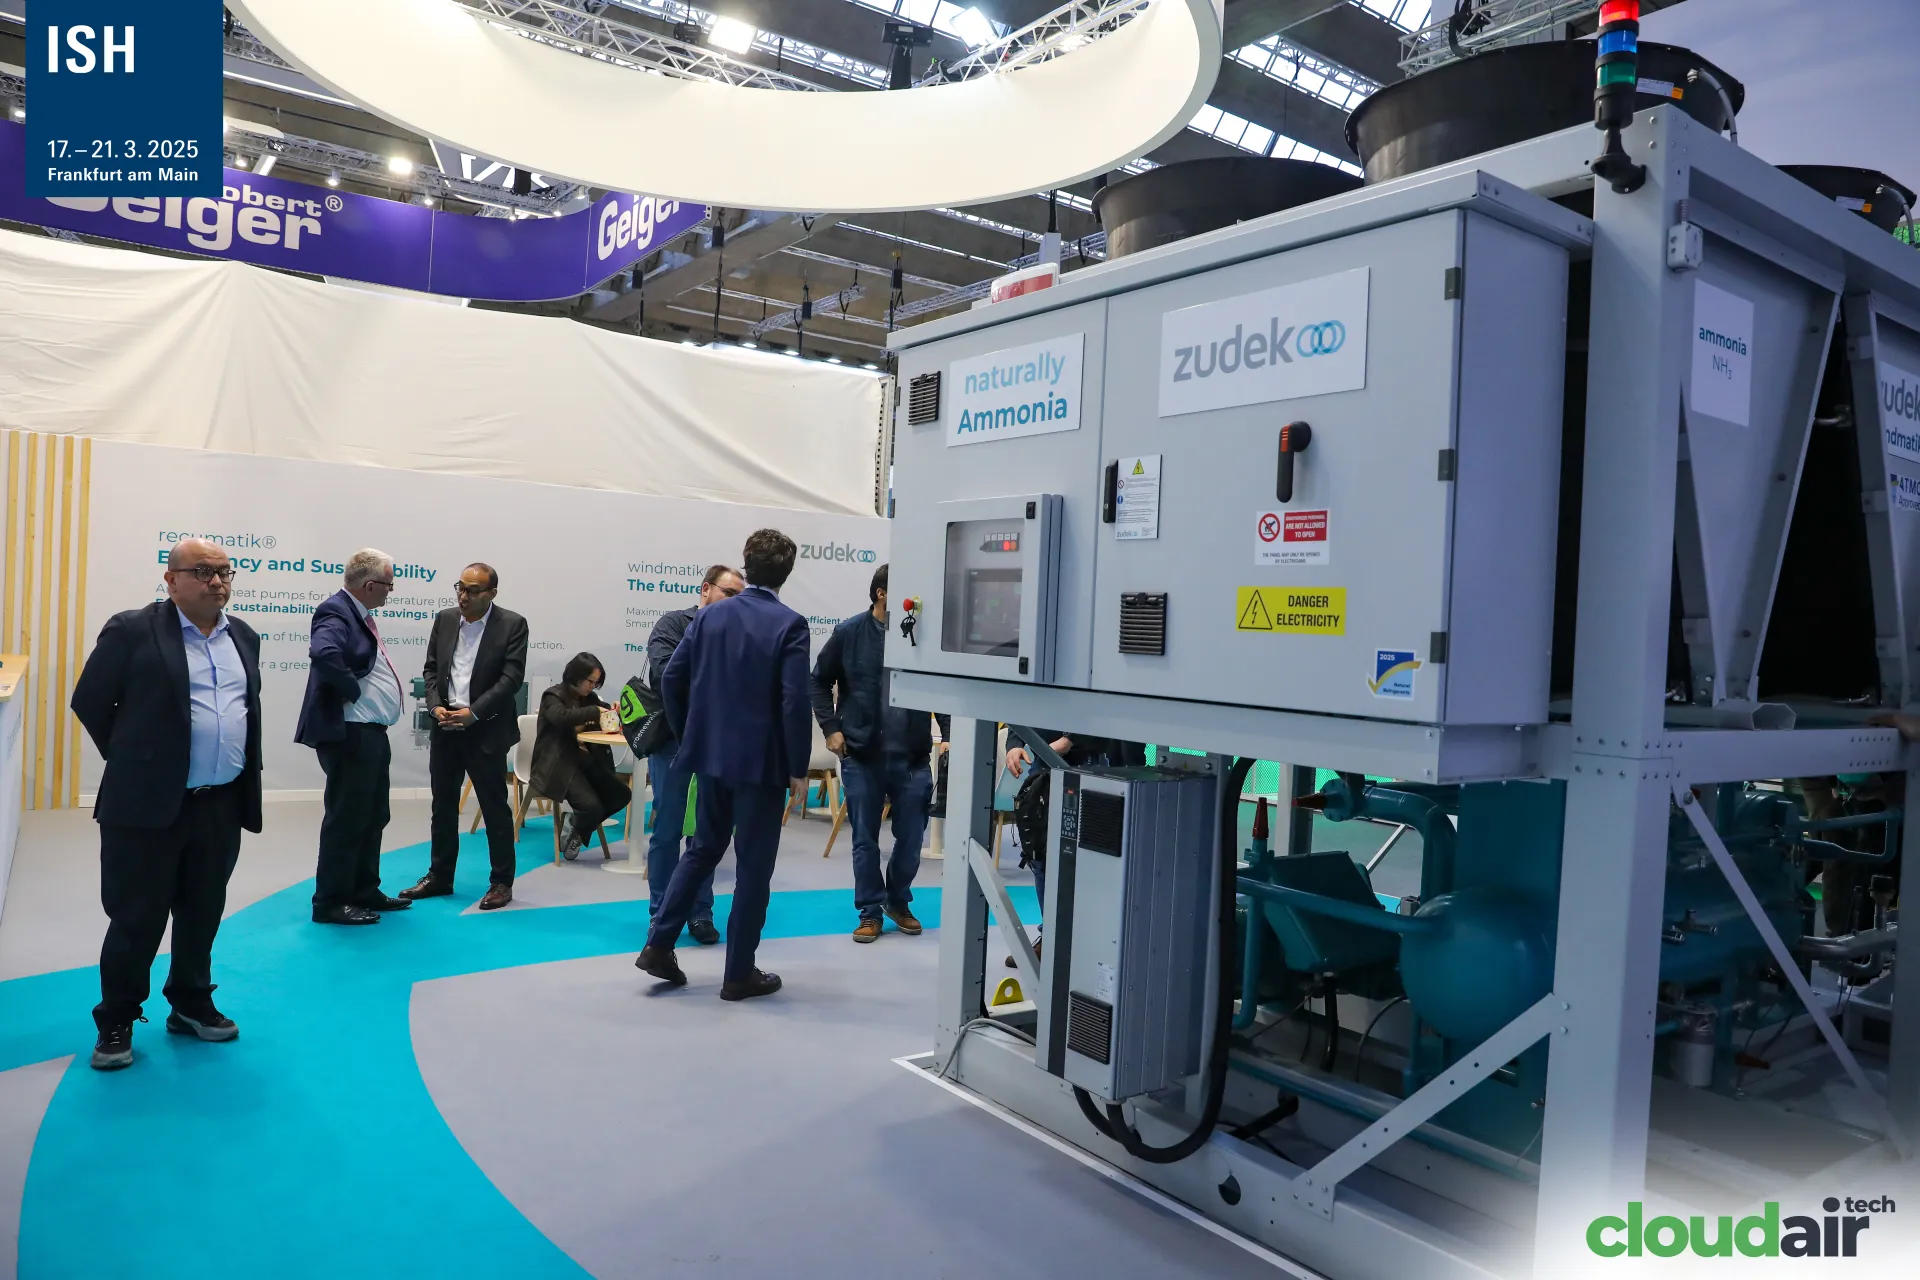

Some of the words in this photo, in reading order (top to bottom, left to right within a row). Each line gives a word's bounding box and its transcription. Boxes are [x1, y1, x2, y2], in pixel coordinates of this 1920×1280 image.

[45, 197, 321, 251] eiger
[1699, 327, 1746, 355] ammonia
[1173, 317, 1295, 382] zudek
[965, 350, 1065, 394] naturally
[1882, 379, 1920, 422] udek
[957, 391, 1067, 434] Ammonia
[1304, 521, 1325, 529] ALLOWED
[801, 542, 856, 562] zudek
[268, 558, 305, 571] and
[311, 560, 436, 582] Susbility
[627, 579, 654, 591] The
[659, 580, 702, 594] future
[260, 591, 305, 602] pumps
[309, 590, 325, 600] for
[385, 597, 435, 606] perature
[1288, 595, 1329, 608] DANGER
[382, 608, 428, 620] savings
[626, 607, 667, 616] Maximu
[625, 619, 655, 628] Smart
[1277, 613, 1340, 627] ELECTRICITY
[273, 632, 286, 641] of
[289, 632, 309, 641] the
[402, 636, 427, 645] with
[625, 643, 643, 651] The
[1379, 653, 1395, 661] 2025
[269, 661, 276, 669] a
[280, 661, 309, 671] gree
